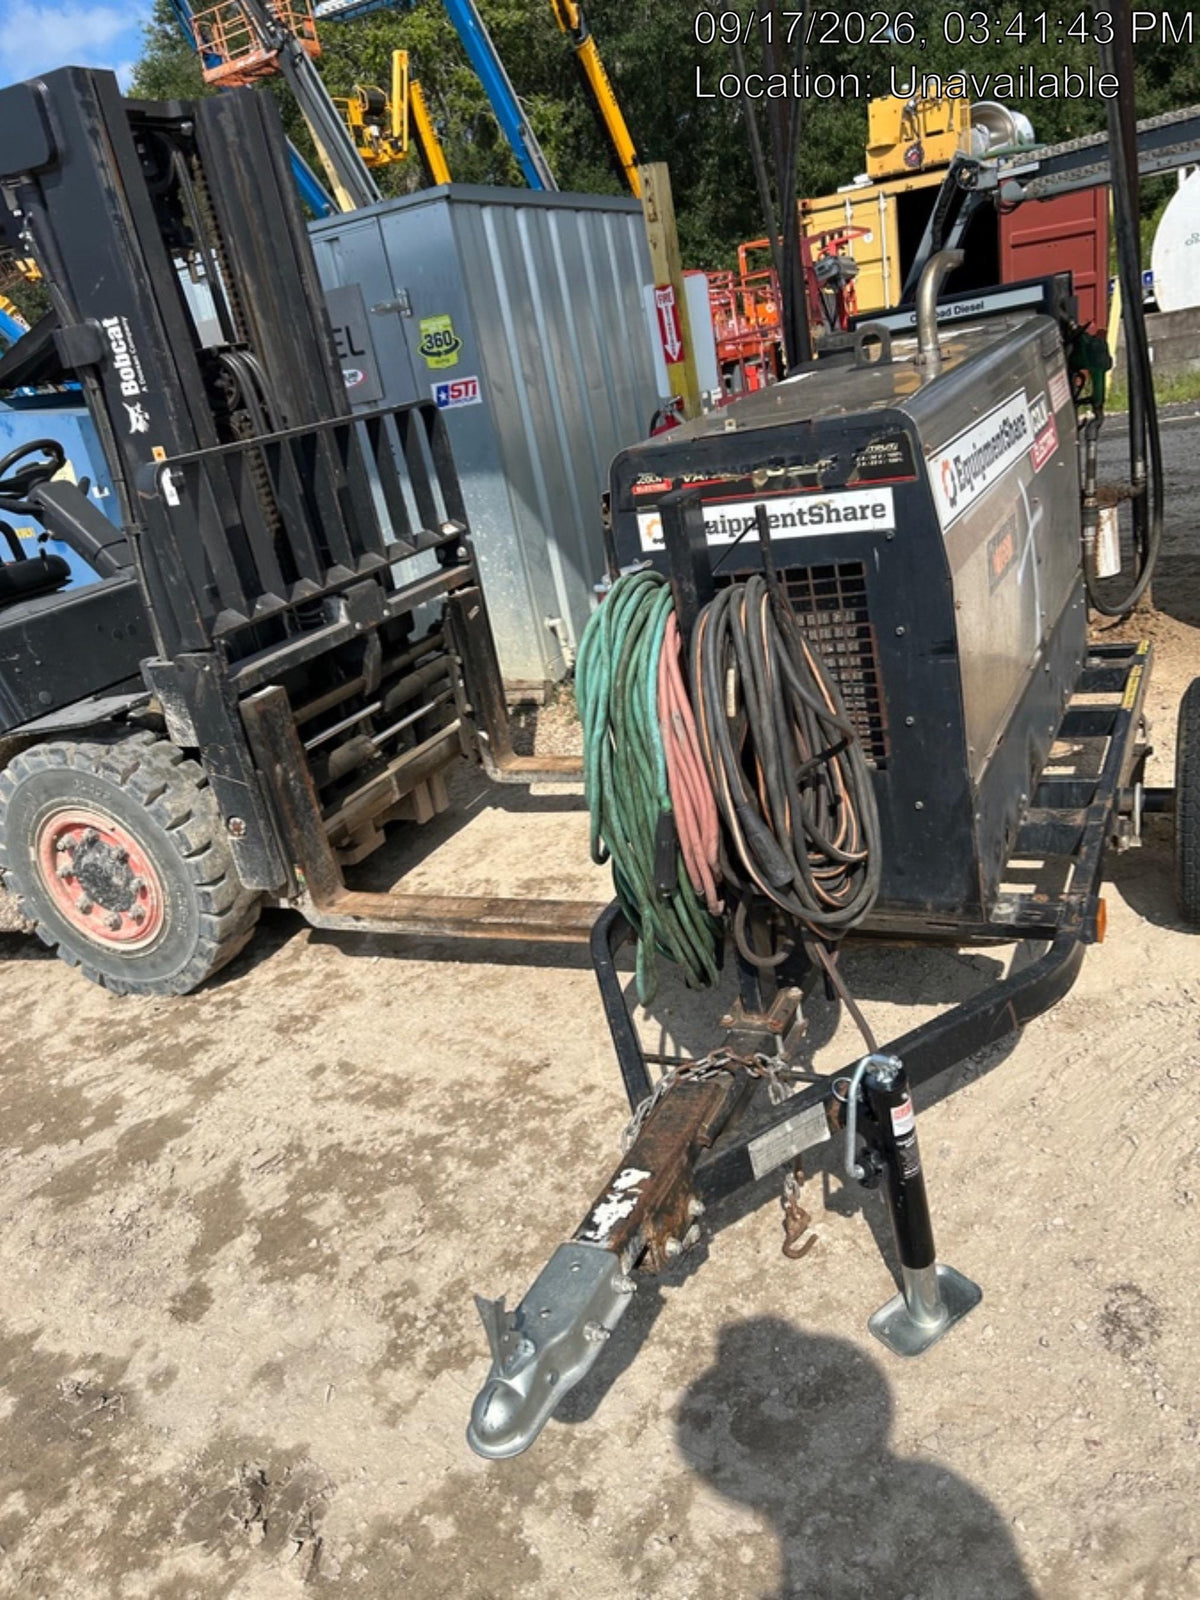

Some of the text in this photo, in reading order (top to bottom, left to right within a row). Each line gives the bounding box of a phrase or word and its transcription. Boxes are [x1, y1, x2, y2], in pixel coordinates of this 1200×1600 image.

[954, 300, 985, 315] Diesel
[101, 315, 140, 398] Bobcat
[424, 329, 453, 351] 360
[952, 412, 1028, 493] EquipmentShare
[705, 501, 887, 538] uipentShare
